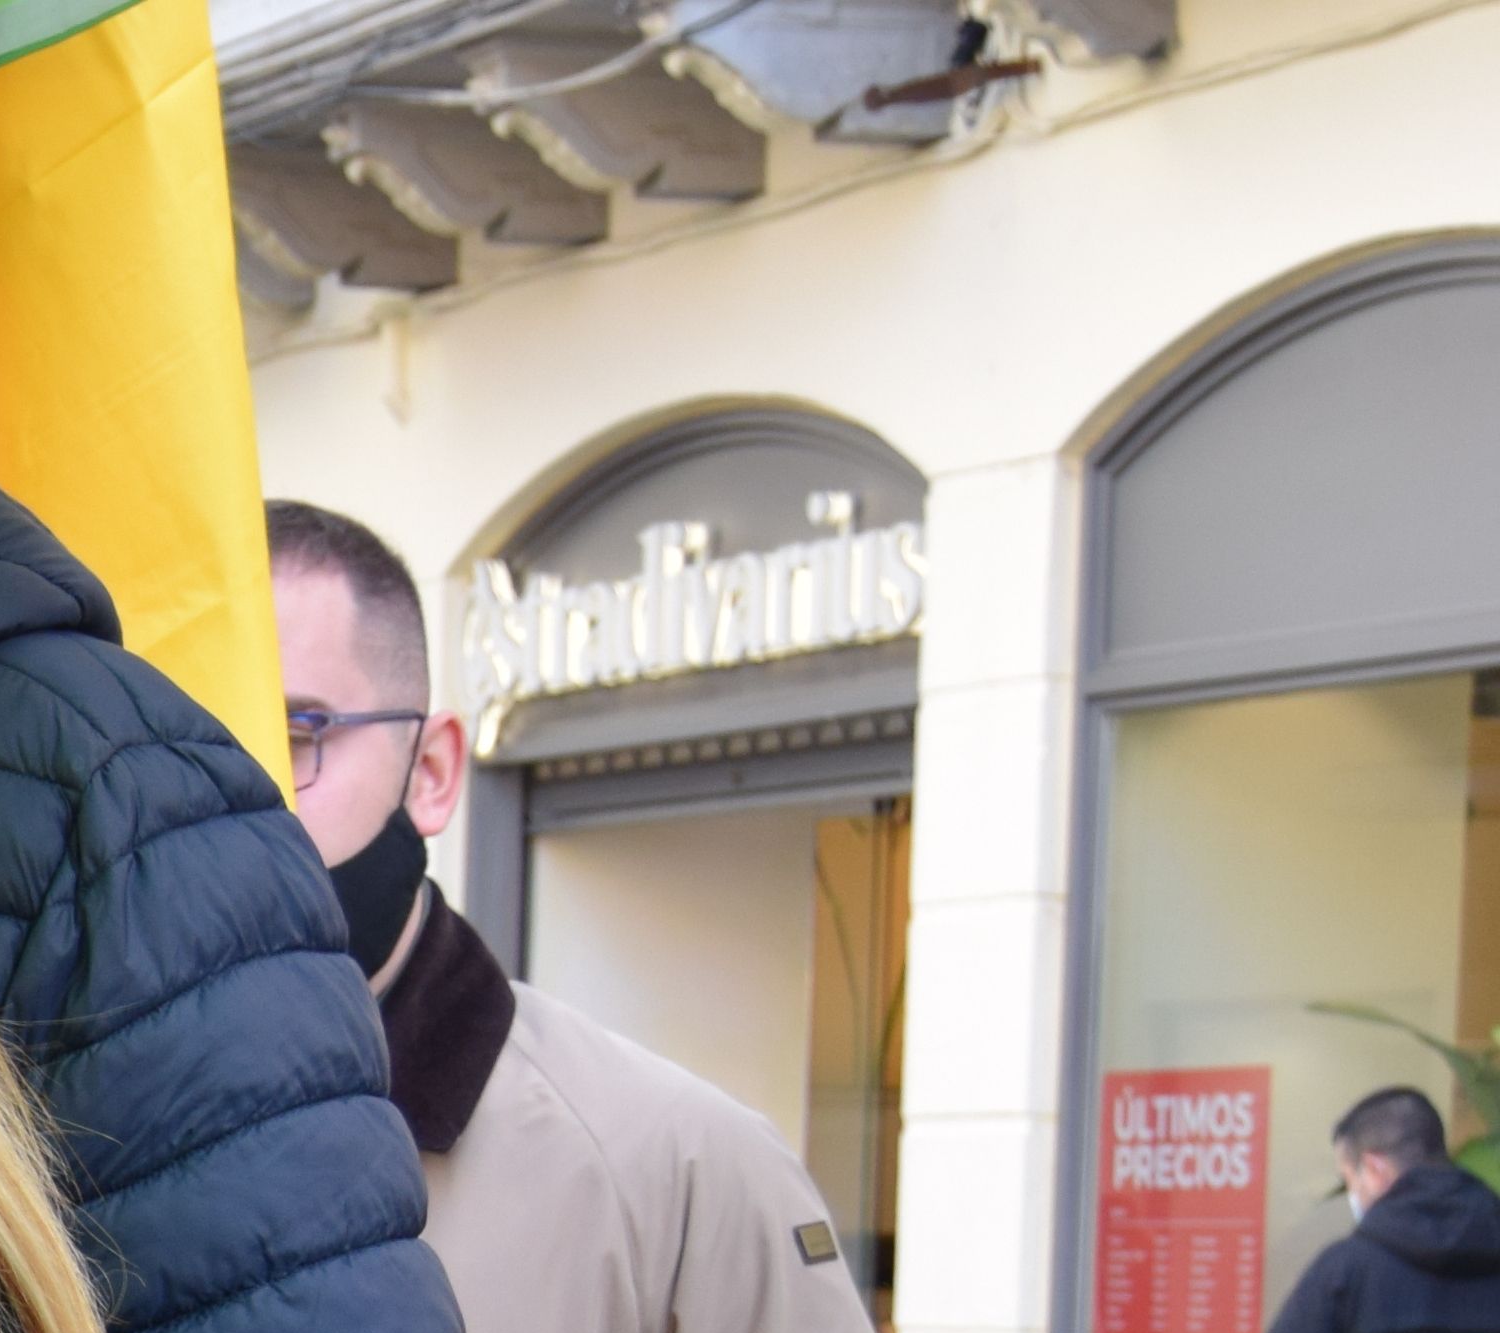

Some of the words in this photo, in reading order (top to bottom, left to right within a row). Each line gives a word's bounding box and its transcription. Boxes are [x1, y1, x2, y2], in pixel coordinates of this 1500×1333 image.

[462, 490, 928, 758] Stradivarius
[1111, 1085, 1255, 1141] ÚLTIMOS
[1111, 1141, 1252, 1190] PRECIOS
